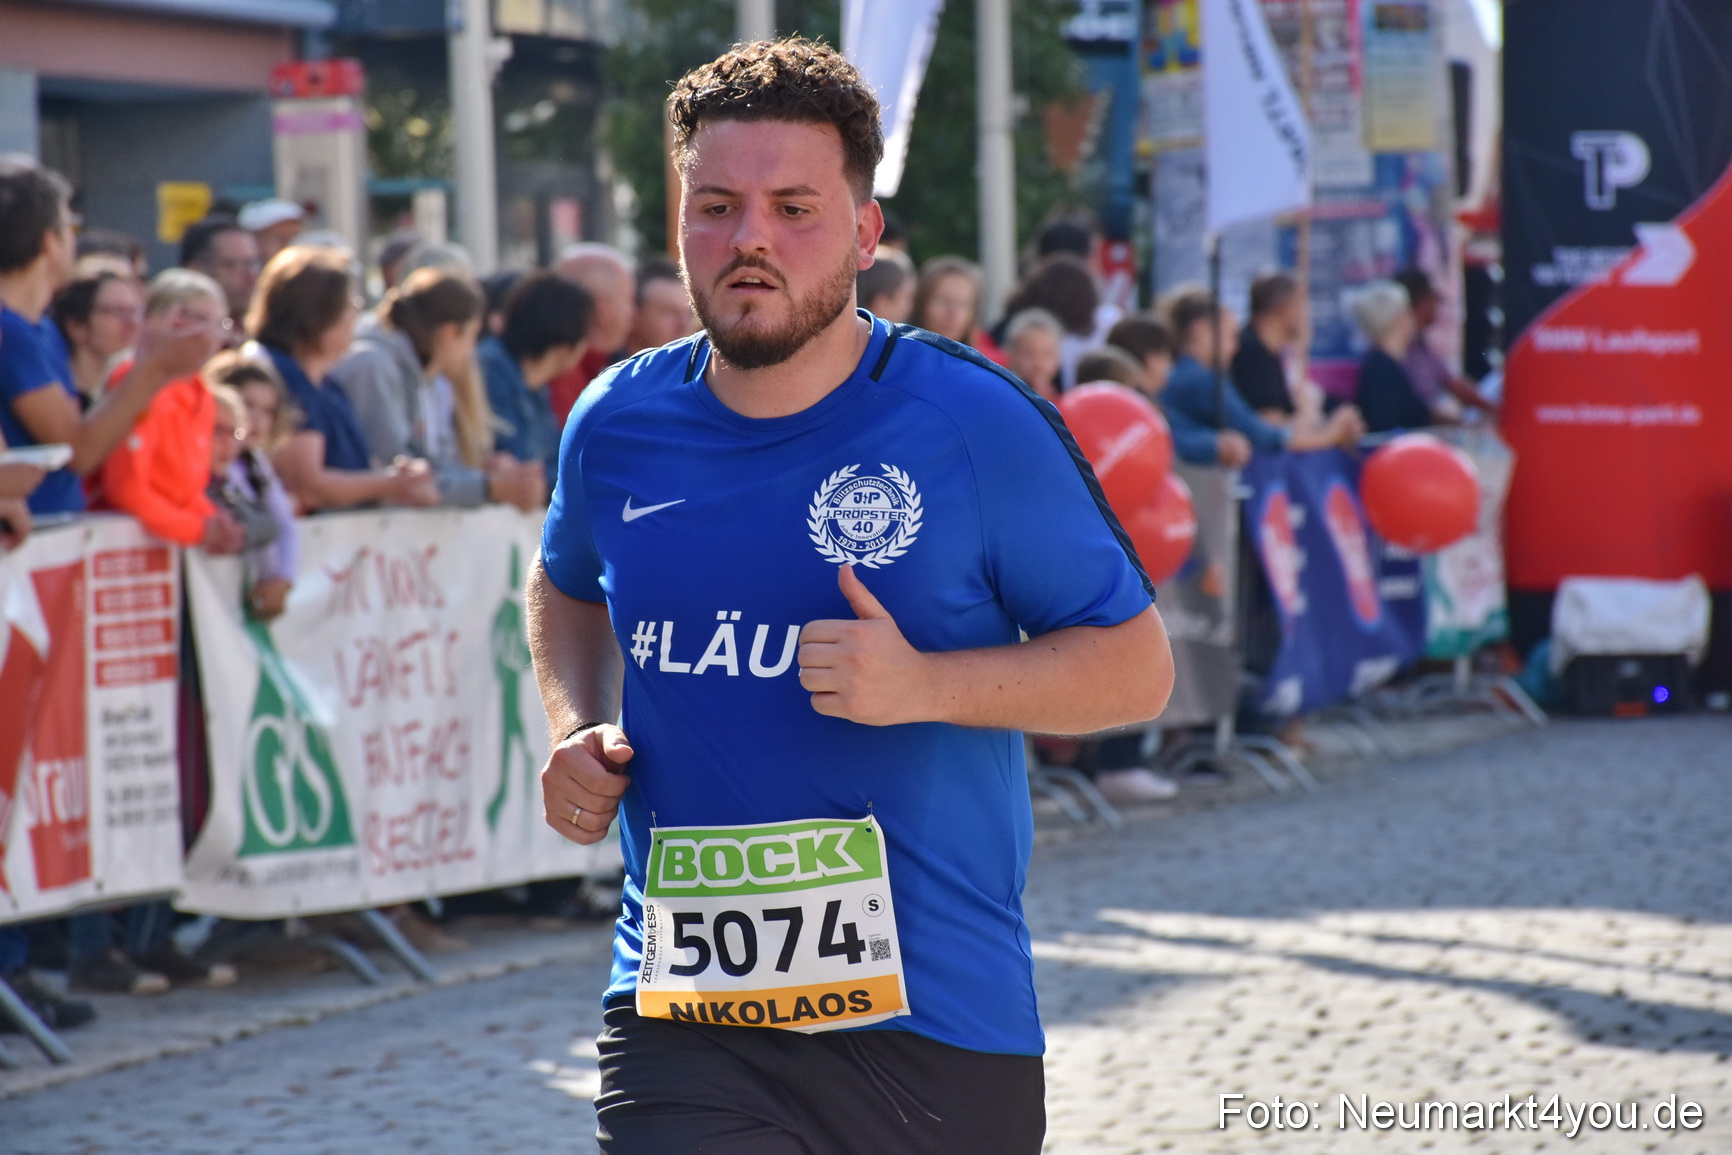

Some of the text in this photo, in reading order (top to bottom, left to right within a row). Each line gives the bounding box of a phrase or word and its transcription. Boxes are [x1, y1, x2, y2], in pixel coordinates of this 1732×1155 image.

[832, 479, 900, 507] Blitzschutztechnik
[823, 508, 908, 520] J.PRÖPSTER
[852, 521, 873, 533] 40
[855, 525, 887, 540] Innovation
[838, 536, 857, 549] 1979
[865, 536, 887, 549] 2019
[630, 610, 801, 678] #LÄU
[659, 828, 862, 887] BOCK
[868, 899, 879, 911] S
[668, 899, 867, 977] 5074
[669, 990, 873, 1025] NIKOLAOS
